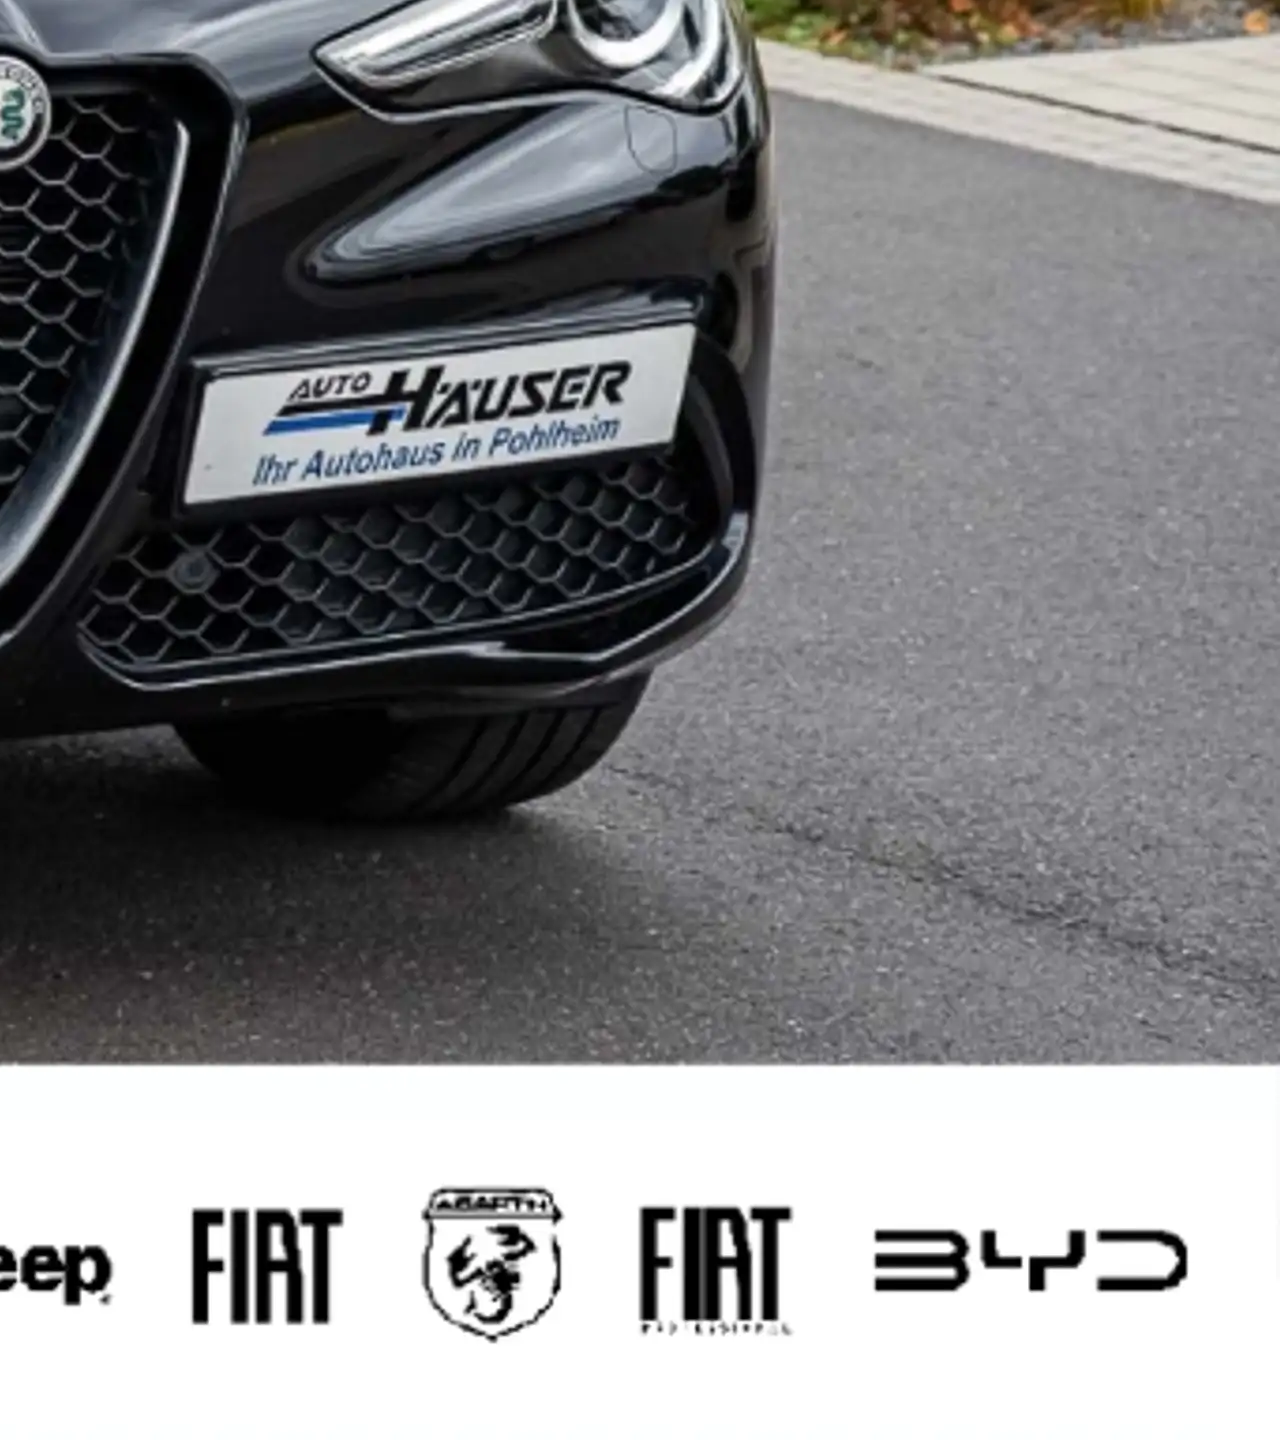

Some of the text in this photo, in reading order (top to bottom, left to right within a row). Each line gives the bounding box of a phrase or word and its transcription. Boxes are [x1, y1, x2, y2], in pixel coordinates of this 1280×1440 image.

[288, 361, 631, 436] AUTO HÄUSER
[253, 414, 620, 486] Ihr Autohaus in Pohlheim
